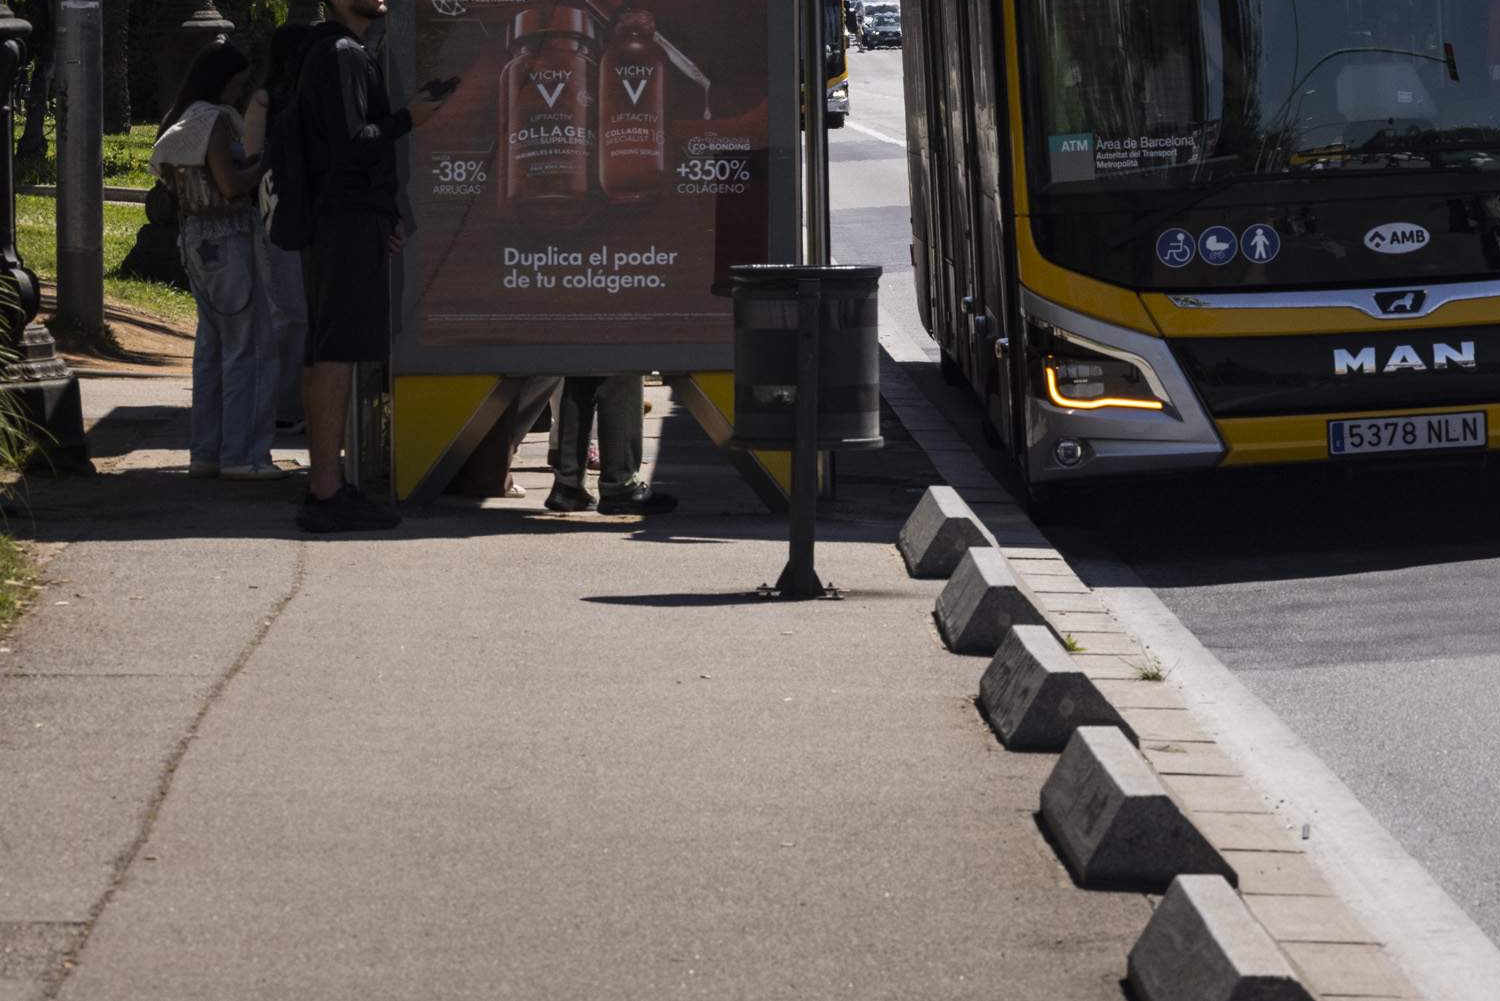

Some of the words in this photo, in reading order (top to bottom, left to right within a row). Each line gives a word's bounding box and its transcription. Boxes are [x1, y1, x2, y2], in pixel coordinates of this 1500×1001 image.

[529, 70, 572, 81] VICHY
[616, 66, 655, 76] VICHY
[1061, 139, 1088, 153] ATM
[1124, 137, 1137, 149] de
[1140, 135, 1195, 149] Barcelona
[1096, 151, 1128, 160] Autoritat
[1143, 149, 1177, 160] Transport
[432, 161, 487, 181] -38%
[676, 160, 750, 180] +350%
[432, 184, 482, 194] ARRUGAS
[1390, 230, 1426, 245] AMB
[504, 246, 582, 270] Duplica
[589, 245, 607, 266] el
[614, 245, 678, 270] poder
[504, 269, 530, 288] de
[536, 271, 556, 288] tu
[562, 268, 665, 294] colágeno.
[1333, 341, 1477, 376] MAN
[1349, 421, 1418, 448] 5378
[1427, 417, 1479, 445] NLN
